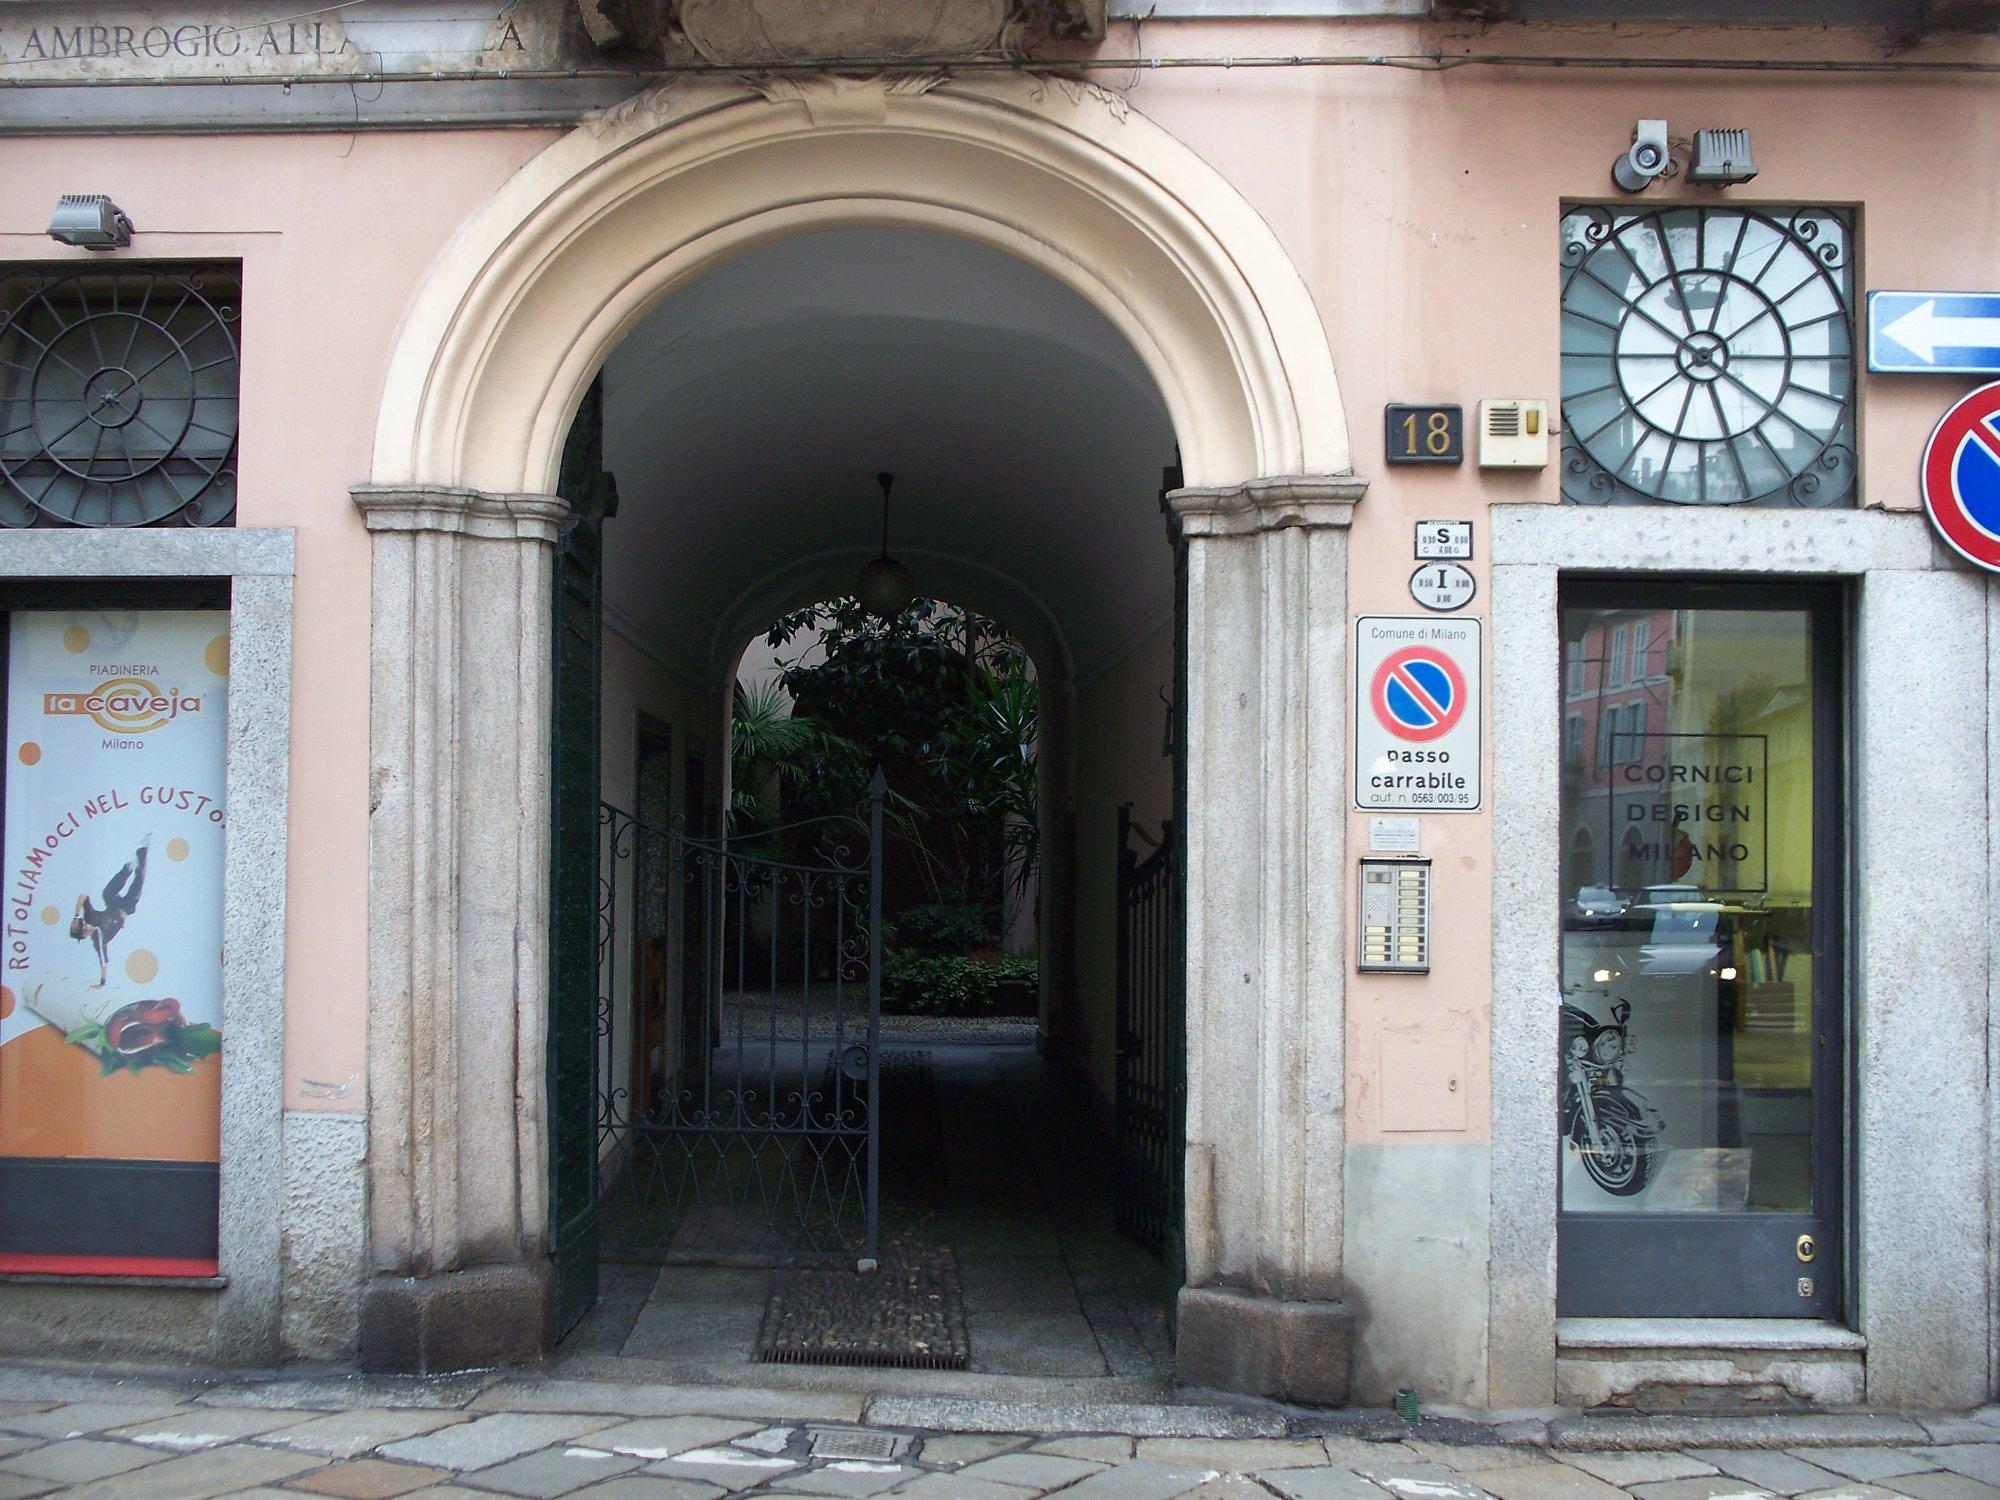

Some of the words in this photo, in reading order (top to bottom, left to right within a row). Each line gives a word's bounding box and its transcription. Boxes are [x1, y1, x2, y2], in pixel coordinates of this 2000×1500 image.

[21, 24, 242, 59] AMBROGIO
[1403, 412, 1451, 456] 18
[1437, 528, 1451, 544] S
[1437, 569, 1448, 589] I
[1371, 628, 1415, 639] Comune
[1418, 628, 1428, 639] di
[1431, 628, 1467, 640] Milano
[90, 665, 159, 676] PIADINERIA
[49, 695, 76, 711] la
[85, 687, 201, 719] caveja
[101, 738, 144, 750] Milano
[1371, 772, 1466, 789] carrabile
[1624, 764, 1753, 784] CORNICI
[84, 788, 129, 819] NEL
[1370, 791, 1395, 803] aut.
[1626, 803, 1750, 822] DESIGN
